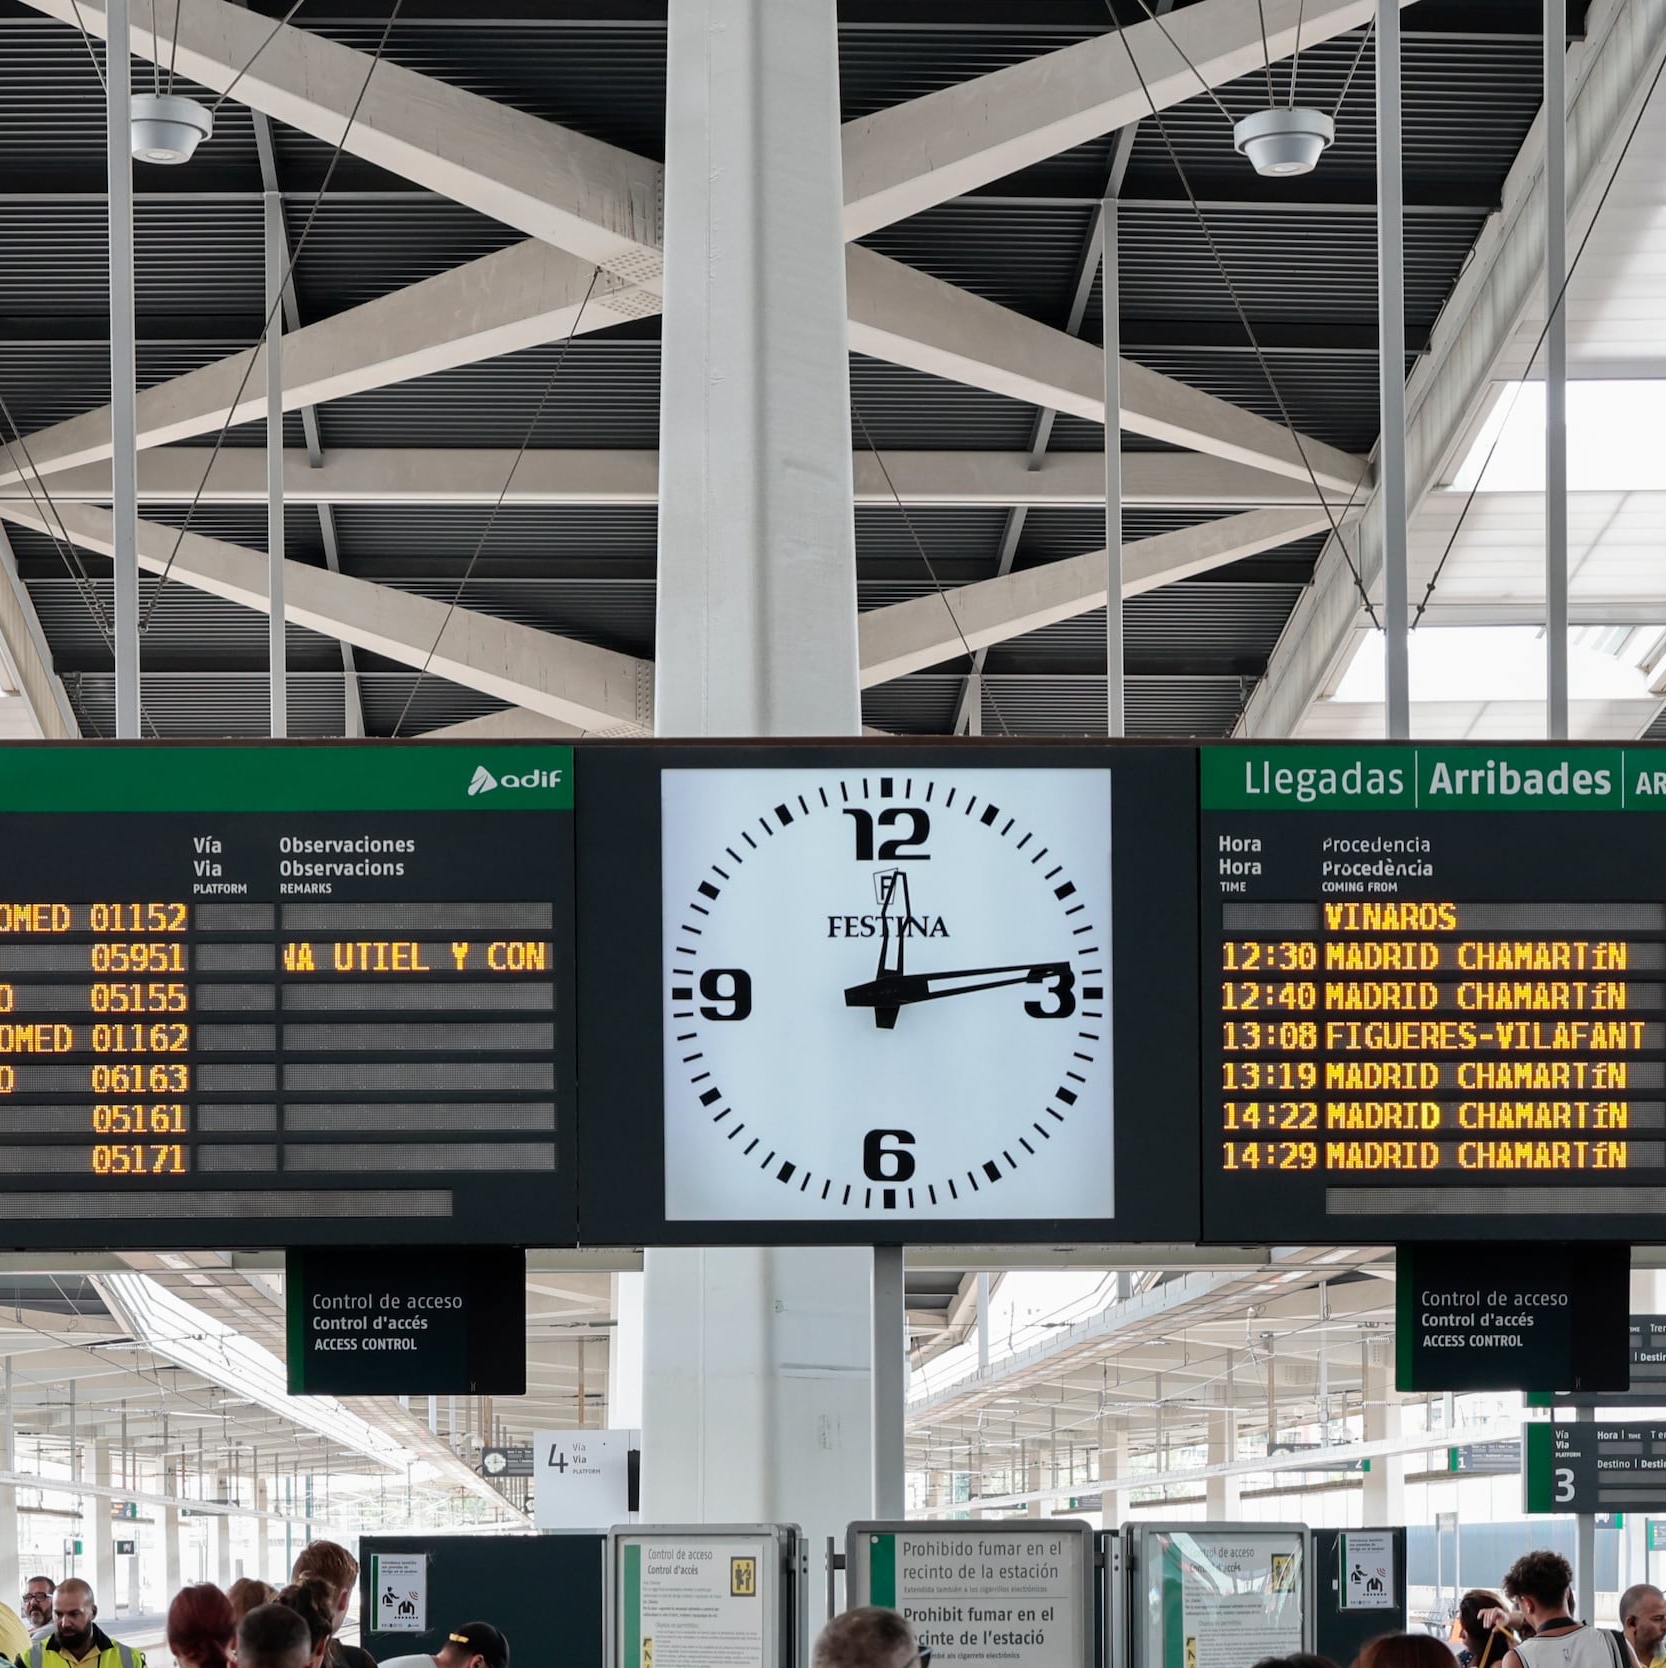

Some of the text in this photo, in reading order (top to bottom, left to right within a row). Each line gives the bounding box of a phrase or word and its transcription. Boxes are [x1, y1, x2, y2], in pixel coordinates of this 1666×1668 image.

[501, 769, 562, 788] adif
[1246, 761, 1403, 802] Llegadas
[1429, 760, 1611, 795] Arribades
[842, 808, 931, 861] 12
[193, 836, 221, 853] Vía
[280, 835, 415, 853] Observaciones
[193, 860, 222, 877] Via
[280, 859, 404, 876] Observacions
[193, 883, 247, 894] PLATFORM
[280, 883, 332, 894] REMARKS
[89, 902, 188, 933] 01152
[1324, 902, 1458, 932] VINAROS
[827, 915, 950, 939] FESTINA
[91, 943, 183, 973] 05951
[333, 941, 428, 972] UTIEL
[451, 942, 470, 970] Y
[486, 942, 547, 971] CON
[700, 969, 752, 1021] 9
[1024, 965, 1076, 1019] 3
[1224, 1022, 1319, 1051] 13:08
[1325, 1021, 1645, 1051] FIGUERES-VILAFANT
[863, 1129, 916, 1182] 6
[1422, 1290, 1568, 1306] Control de acceso
[1421, 1311, 1534, 1328] Control d'accés
[1423, 1335, 1523, 1347] ACCESS CONTROL
[548, 1444, 569, 1473] 4
[1555, 1468, 1575, 1502] 3
[903, 1540, 1061, 1556] Prohibido fumar en el
[903, 1563, 1058, 1579] recinto de la estación
[904, 1607, 1053, 1622] Prohibit fumar en el
[960, 1631, 978, 1645] de
